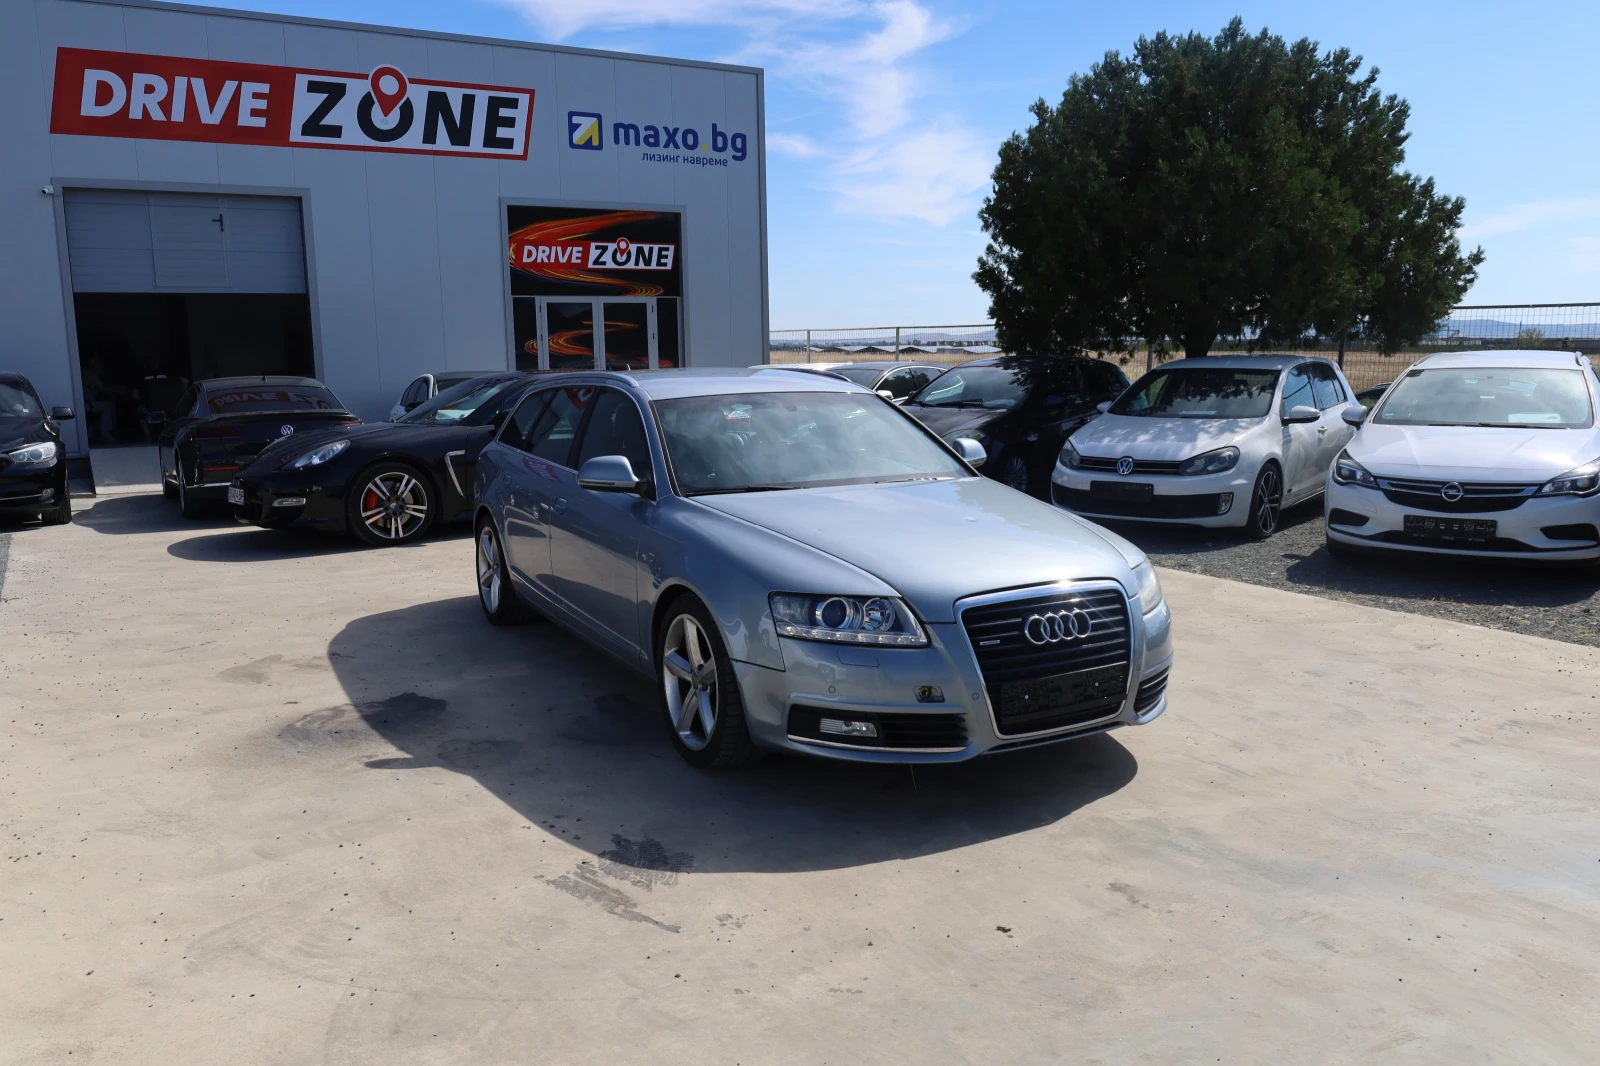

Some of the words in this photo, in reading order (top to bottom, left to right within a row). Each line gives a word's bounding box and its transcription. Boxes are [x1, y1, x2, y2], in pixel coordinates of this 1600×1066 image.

[80, 68, 270, 128] DRIVE
[301, 80, 519, 149] ZONE
[613, 122, 747, 162] maxo.bg
[642, 152, 680, 164] лизинг
[682, 155, 728, 168] навреме
[522, 245, 583, 264] DRIVE
[592, 244, 670, 267] ZONE
